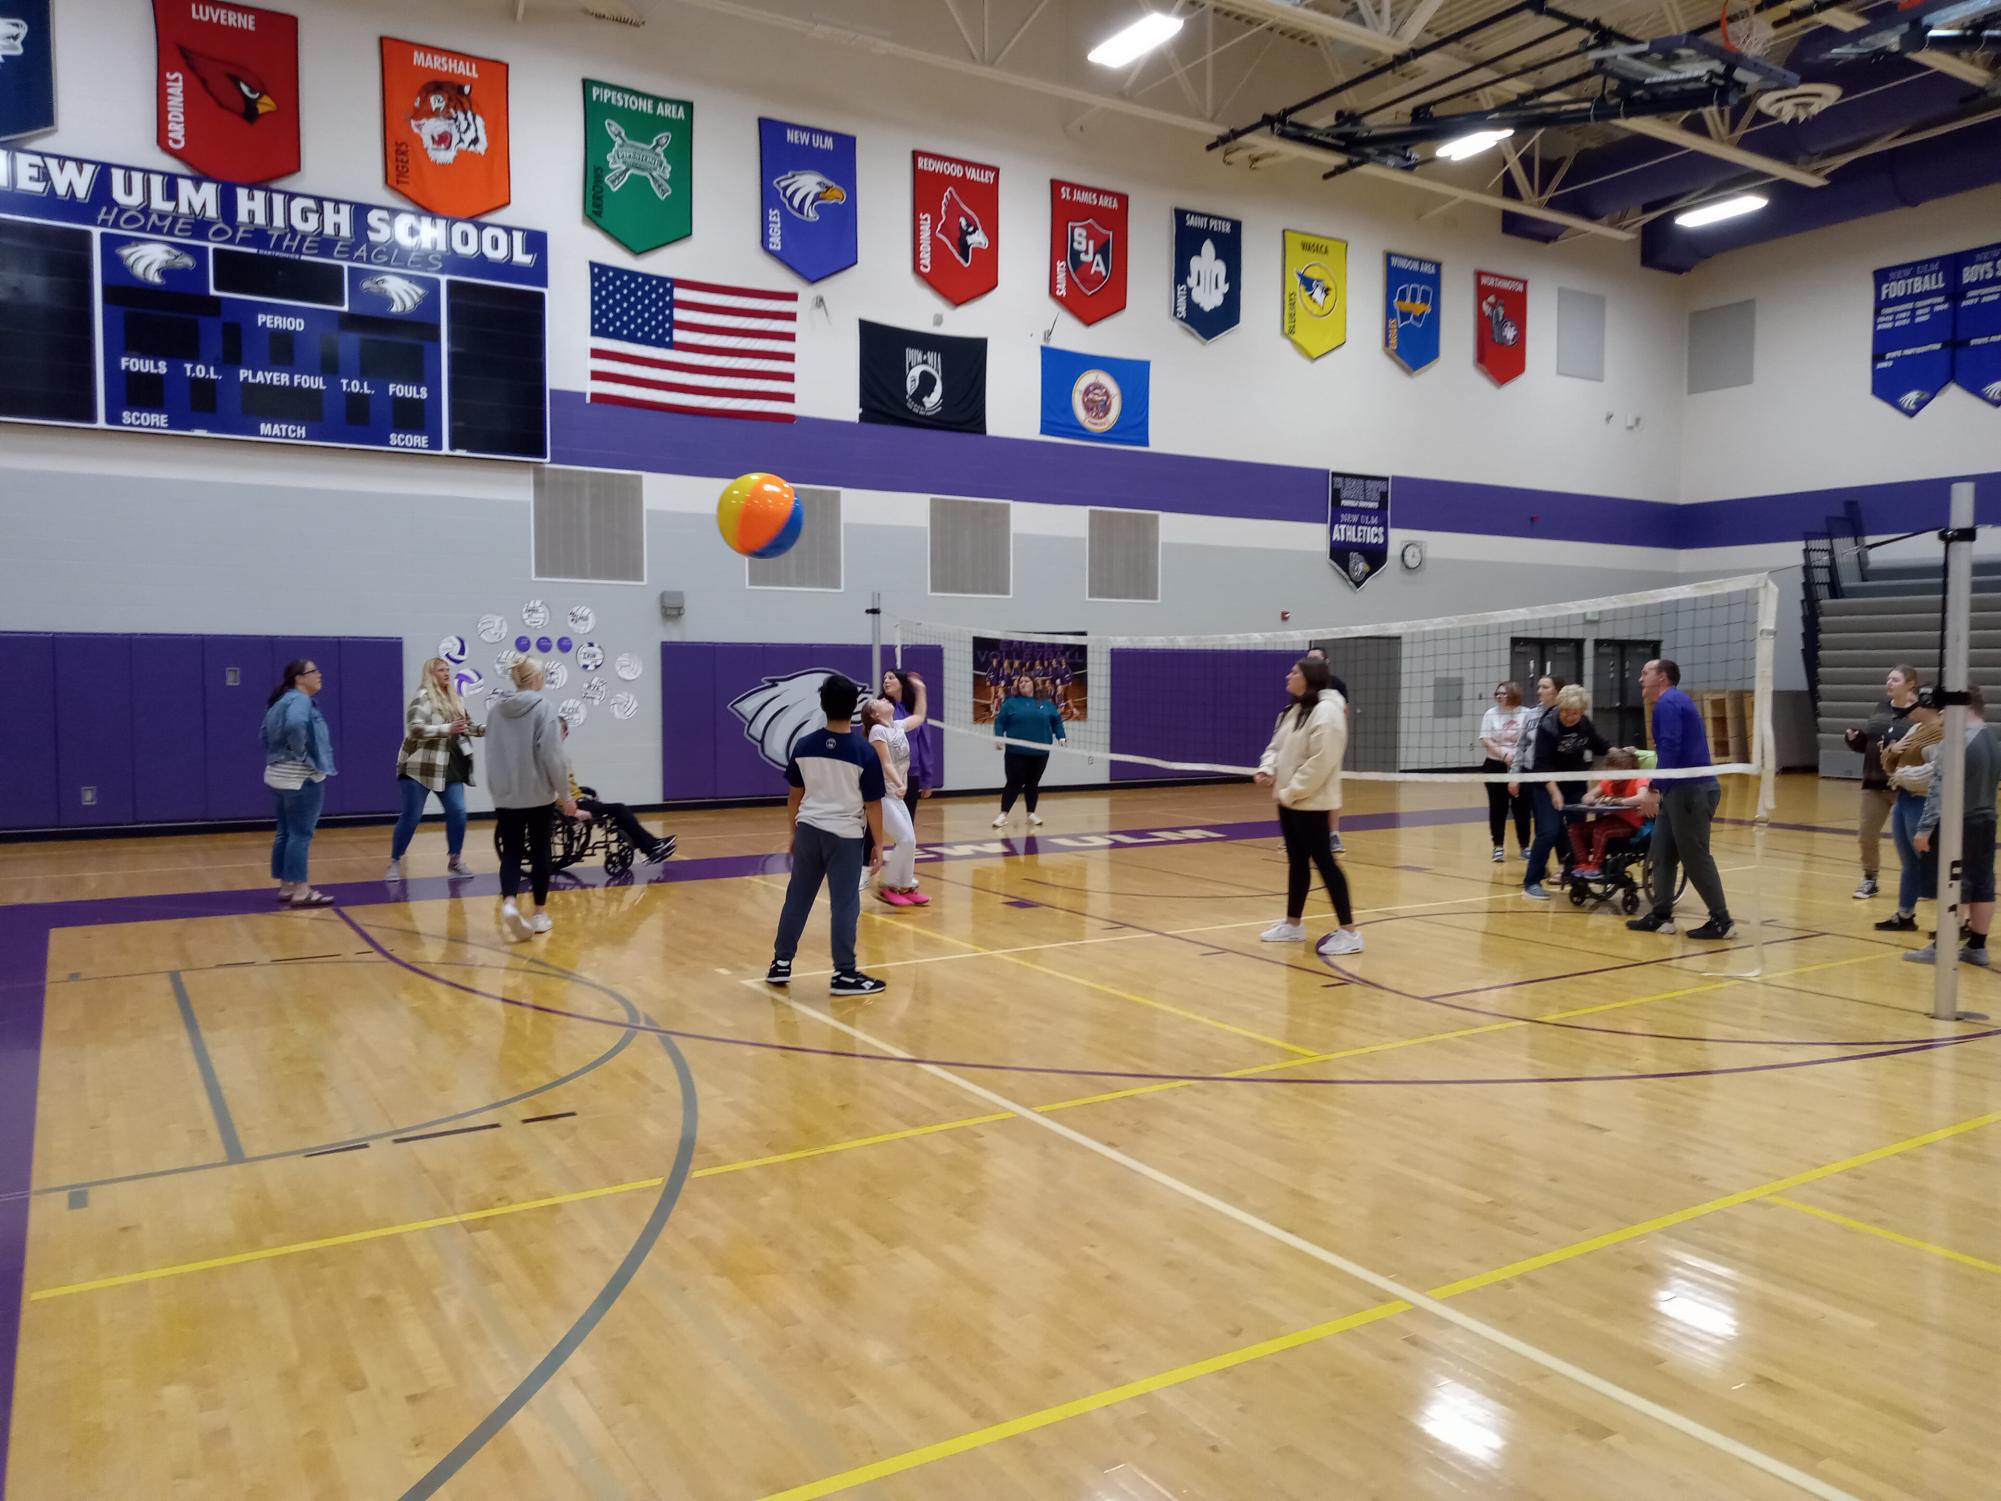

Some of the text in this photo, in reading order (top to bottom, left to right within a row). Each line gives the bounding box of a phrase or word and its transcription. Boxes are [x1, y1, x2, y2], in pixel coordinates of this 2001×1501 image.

[191, 3, 256, 31] LUVERNE
[412, 50, 479, 79] MARSHALL
[166, 71, 186, 150] CARDINALS
[592, 86, 686, 120] PIPESTONE AREA
[786, 128, 833, 151] NEW ULM
[394, 140, 410, 185] TIGERS
[917, 156, 996, 184] REDWOOD VALLEY
[1072, 190, 1098, 207] JAMES
[1098, 195, 1119, 211] AREA
[111, 167, 221, 221] ULM
[236, 186, 355, 242] HIGH
[366, 208, 537, 268] SCHOOL
[1185, 213, 1231, 234] SAINT PETER
[97, 205, 444, 272] HOME OF THE EAGLES
[769, 208, 781, 251] EAGLES
[919, 212, 931, 273] CARDINALS
[1056, 260, 1067, 297] SAINTS
[1962, 263, 1994, 285] BOYS
[1881, 271, 1946, 301] FOOTBALL
[1176, 284, 1187, 319] SAINTS
[257, 313, 305, 331] PERIOD
[120, 356, 168, 374] FOULS
[184, 363, 222, 380] T.O.L.
[239, 369, 327, 390] PLAYER FOUL
[340, 378, 375, 395] T.O.L.
[388, 383, 428, 400] FOULS
[122, 410, 169, 428] SCORE
[259, 422, 306, 439] MATCH
[389, 432, 429, 448] SCORE
[1332, 523, 1385, 545] ATHLETICS
[1048, 828, 1227, 848] ULM
